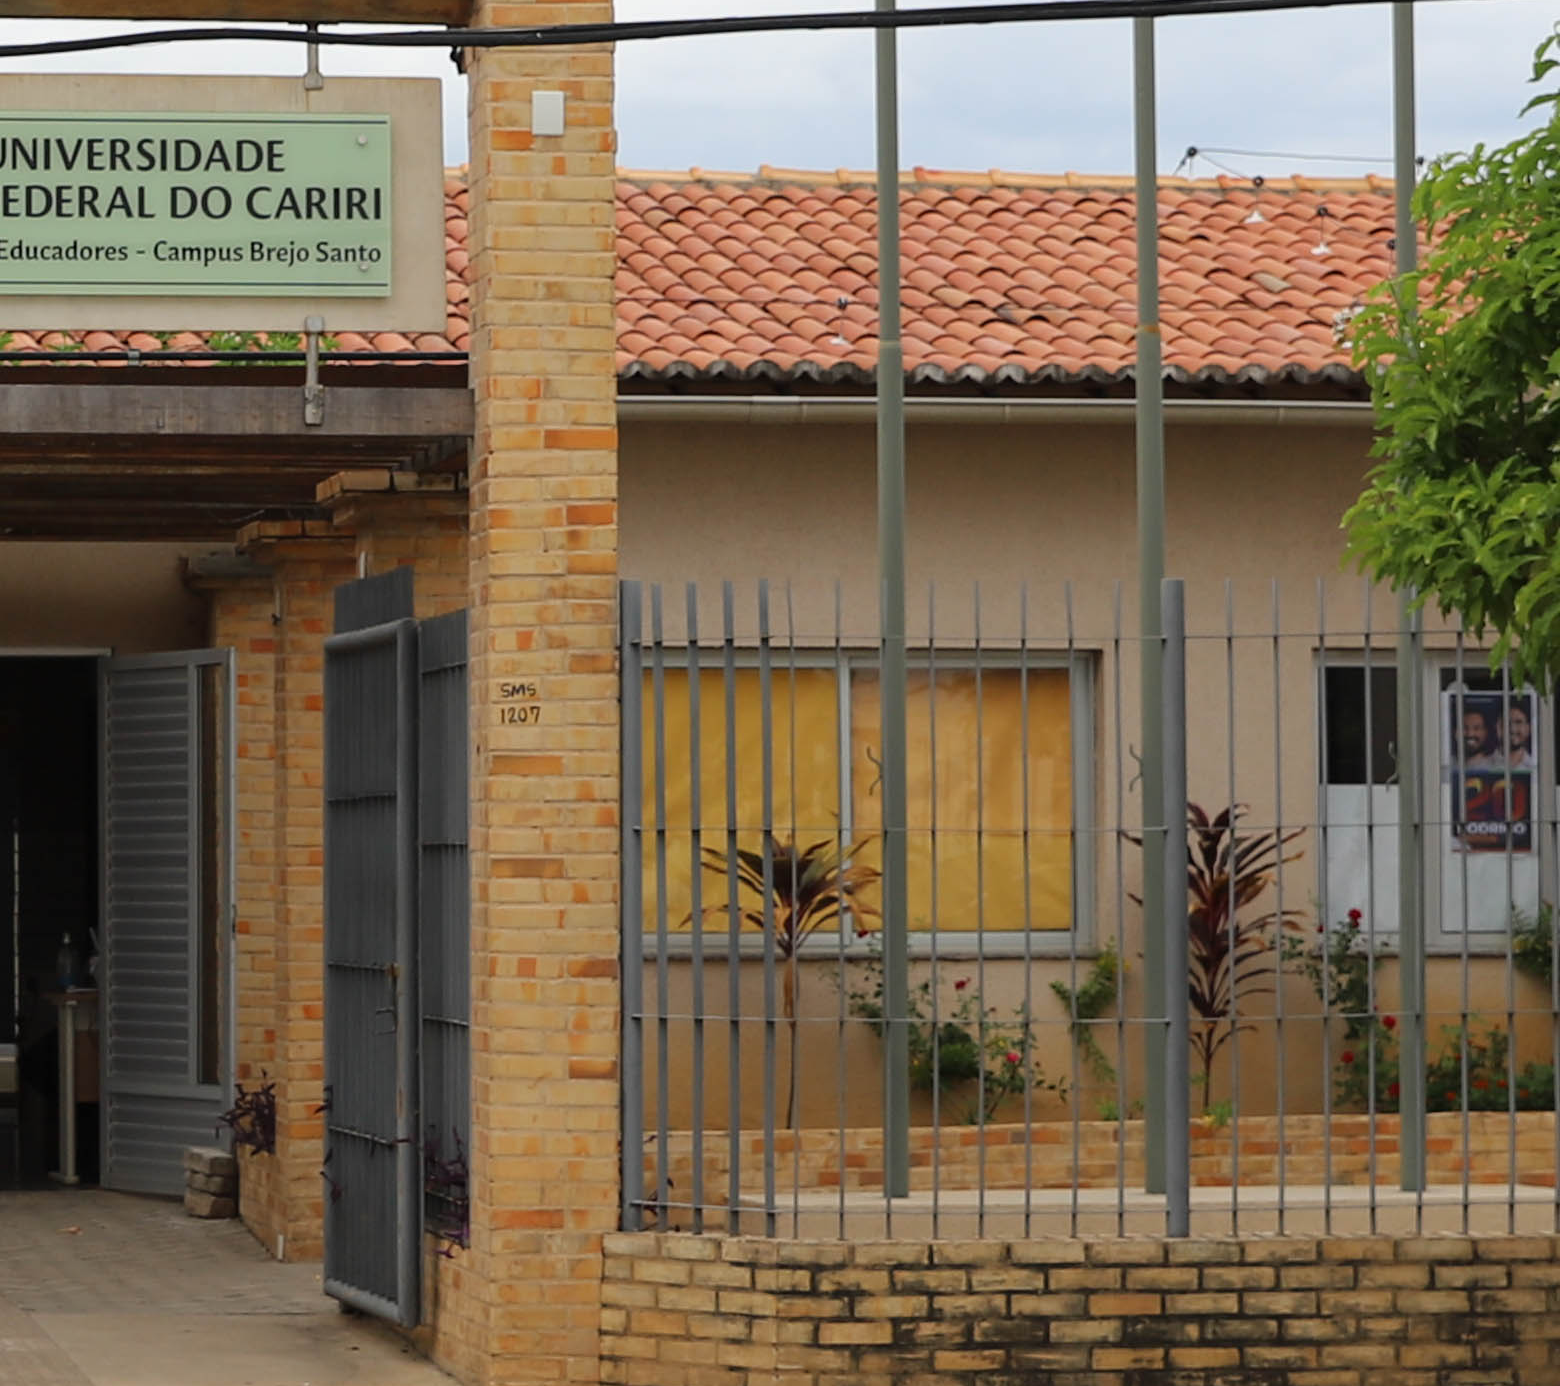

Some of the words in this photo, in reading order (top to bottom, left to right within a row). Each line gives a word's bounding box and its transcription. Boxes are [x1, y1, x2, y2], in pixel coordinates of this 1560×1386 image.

[169, 185, 232, 220] DO
[244, 186, 382, 221] CARIRI
[153, 240, 244, 268] Campus
[250, 240, 310, 268] Brejo
[315, 241, 382, 263] Santo
[500, 683, 536, 698] SMS
[500, 705, 541, 725] 1207
[1460, 777, 1526, 821] 20
